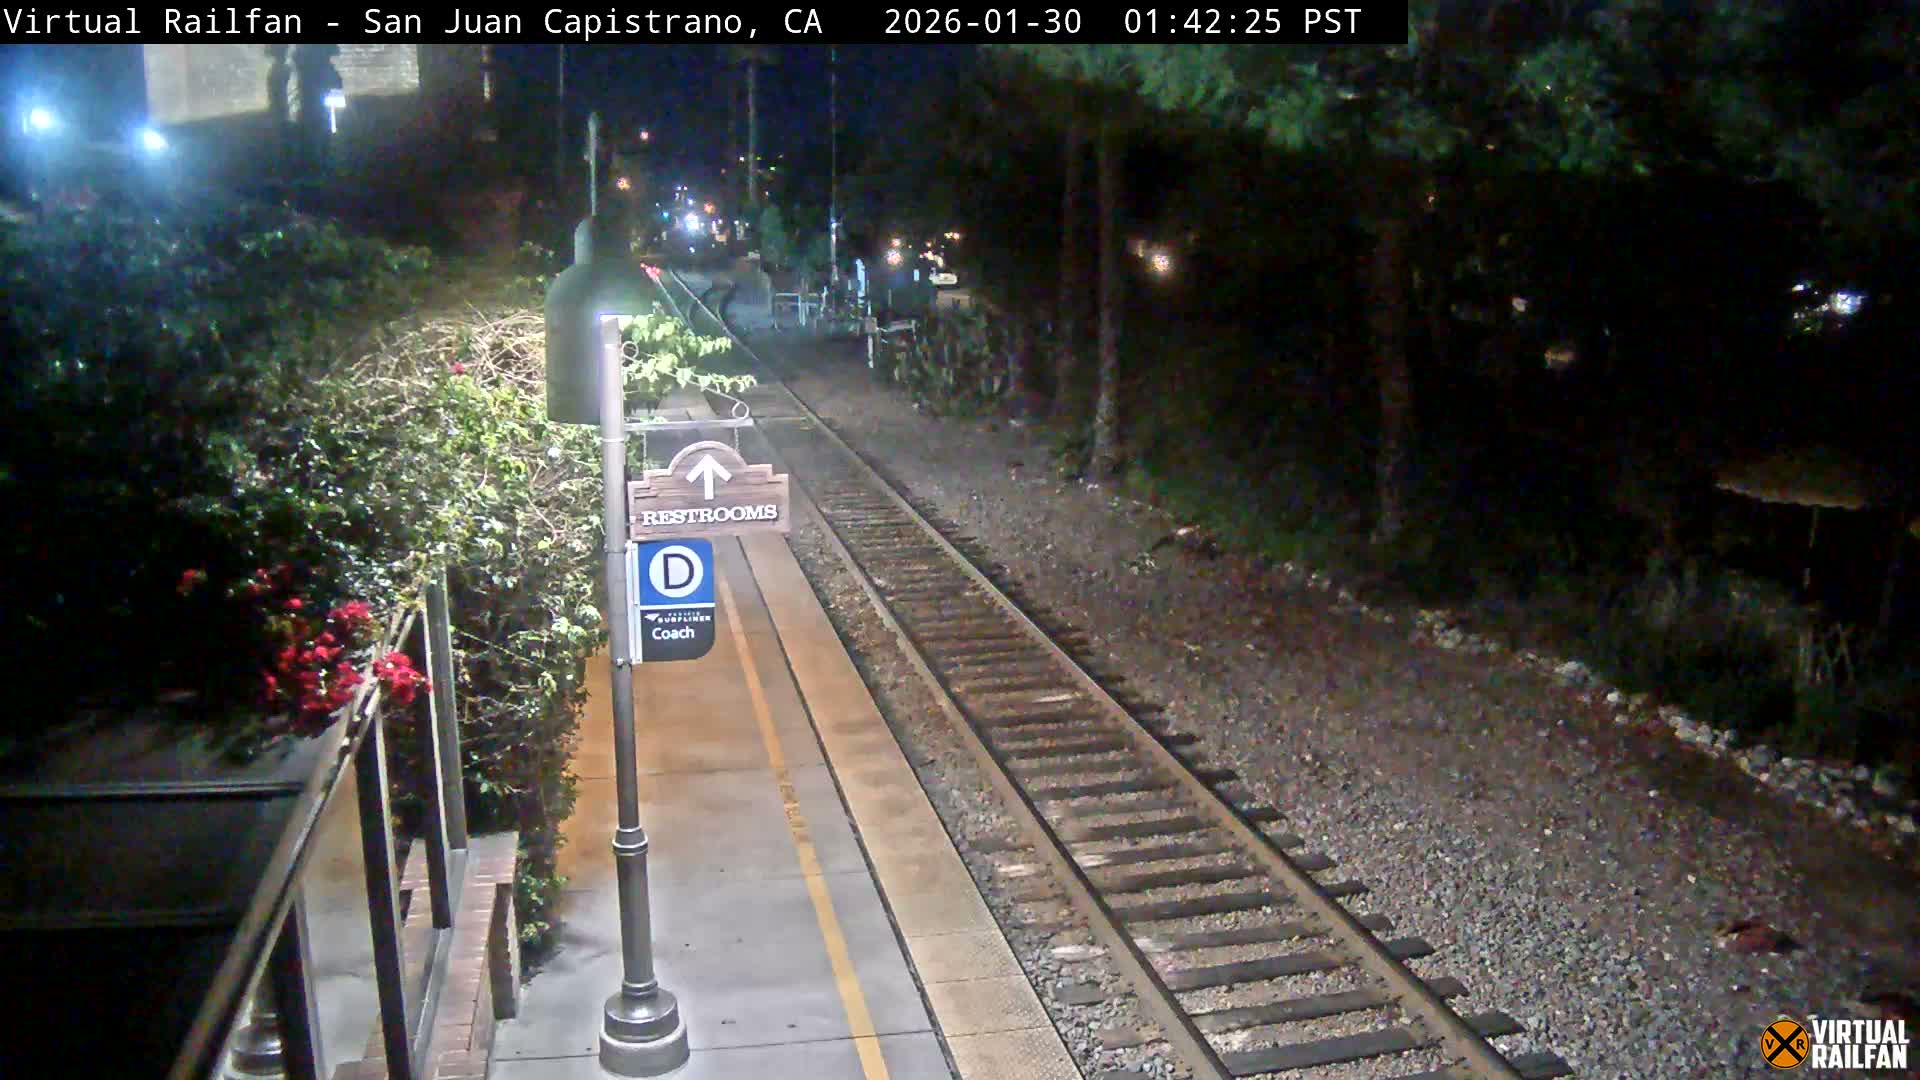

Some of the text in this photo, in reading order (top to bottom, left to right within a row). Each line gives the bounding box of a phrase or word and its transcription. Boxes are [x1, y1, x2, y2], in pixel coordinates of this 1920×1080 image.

[641, 504, 778, 526] RESTROOMS
[663, 553, 695, 590] D
[651, 625, 695, 640] Coach
